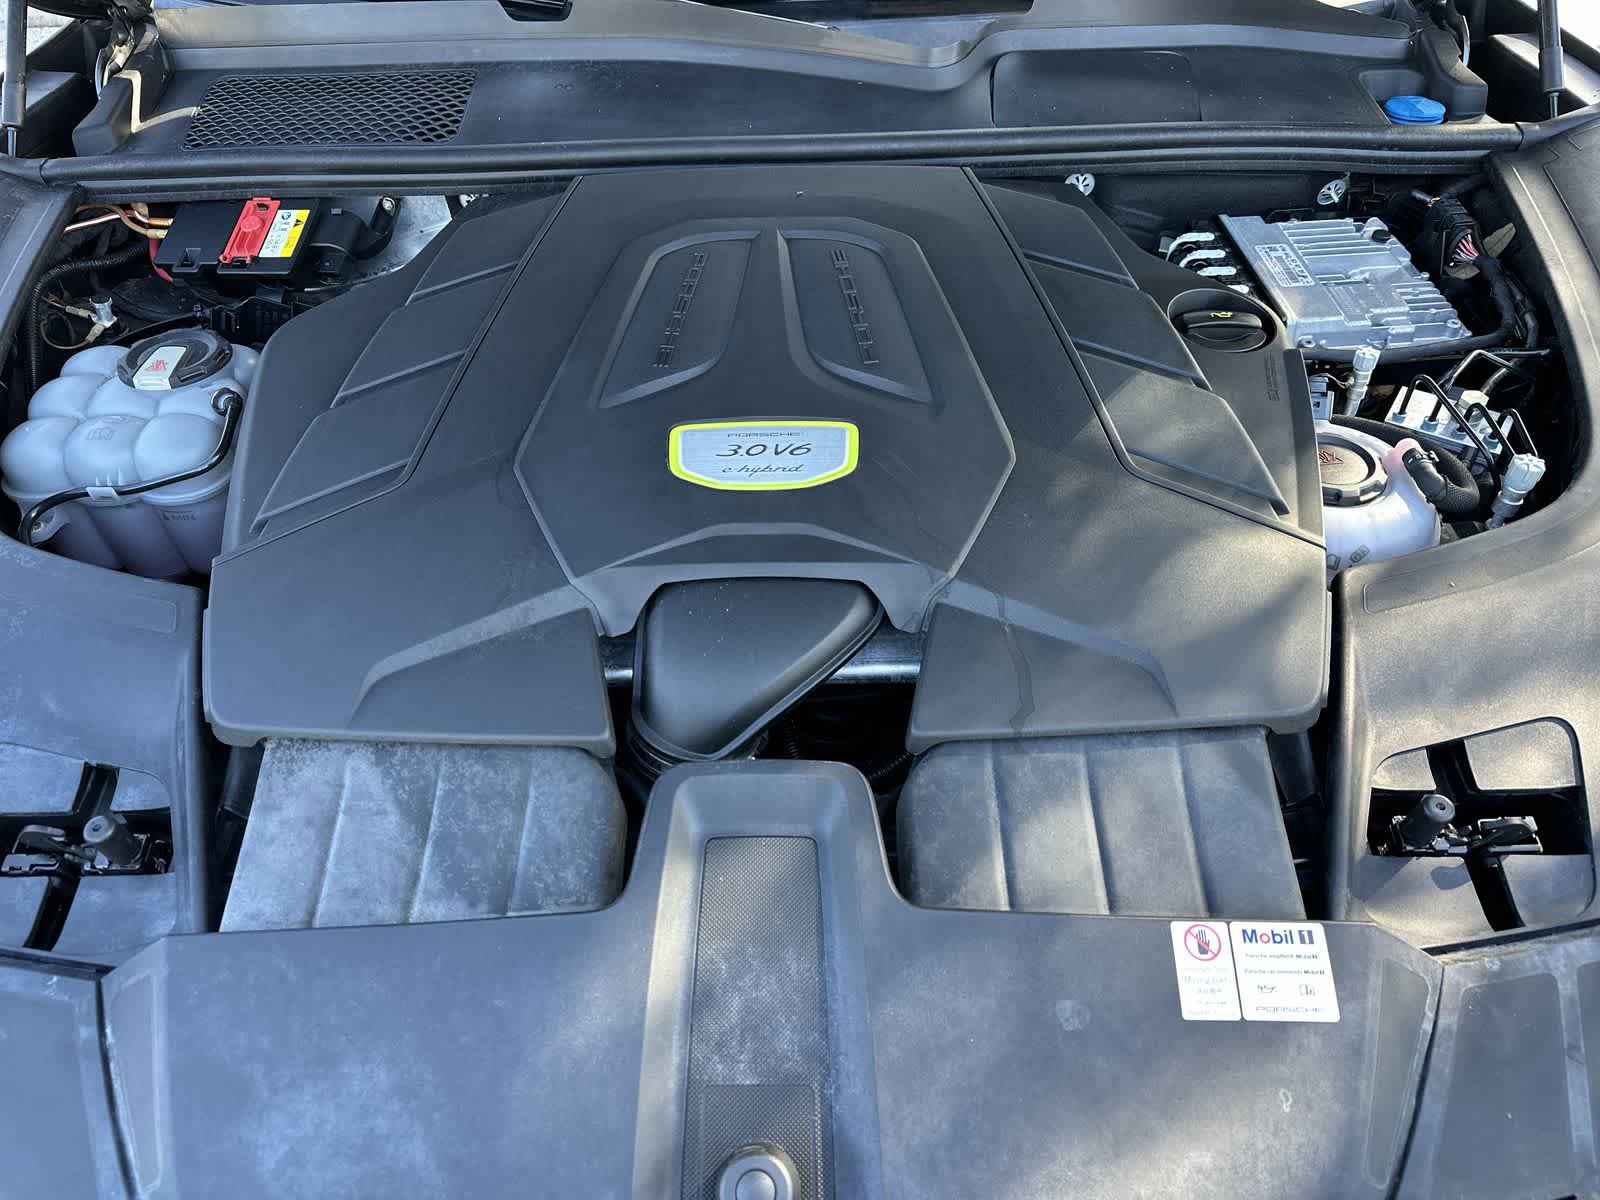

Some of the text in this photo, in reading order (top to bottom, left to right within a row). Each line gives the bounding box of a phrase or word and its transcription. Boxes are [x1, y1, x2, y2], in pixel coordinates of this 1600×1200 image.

[653, 252, 707, 369] PORSCHE
[831, 249, 880, 364] PORSCHE
[716, 443, 812, 457] 3.0 V6
[1242, 929, 1314, 945] Mobil 1
